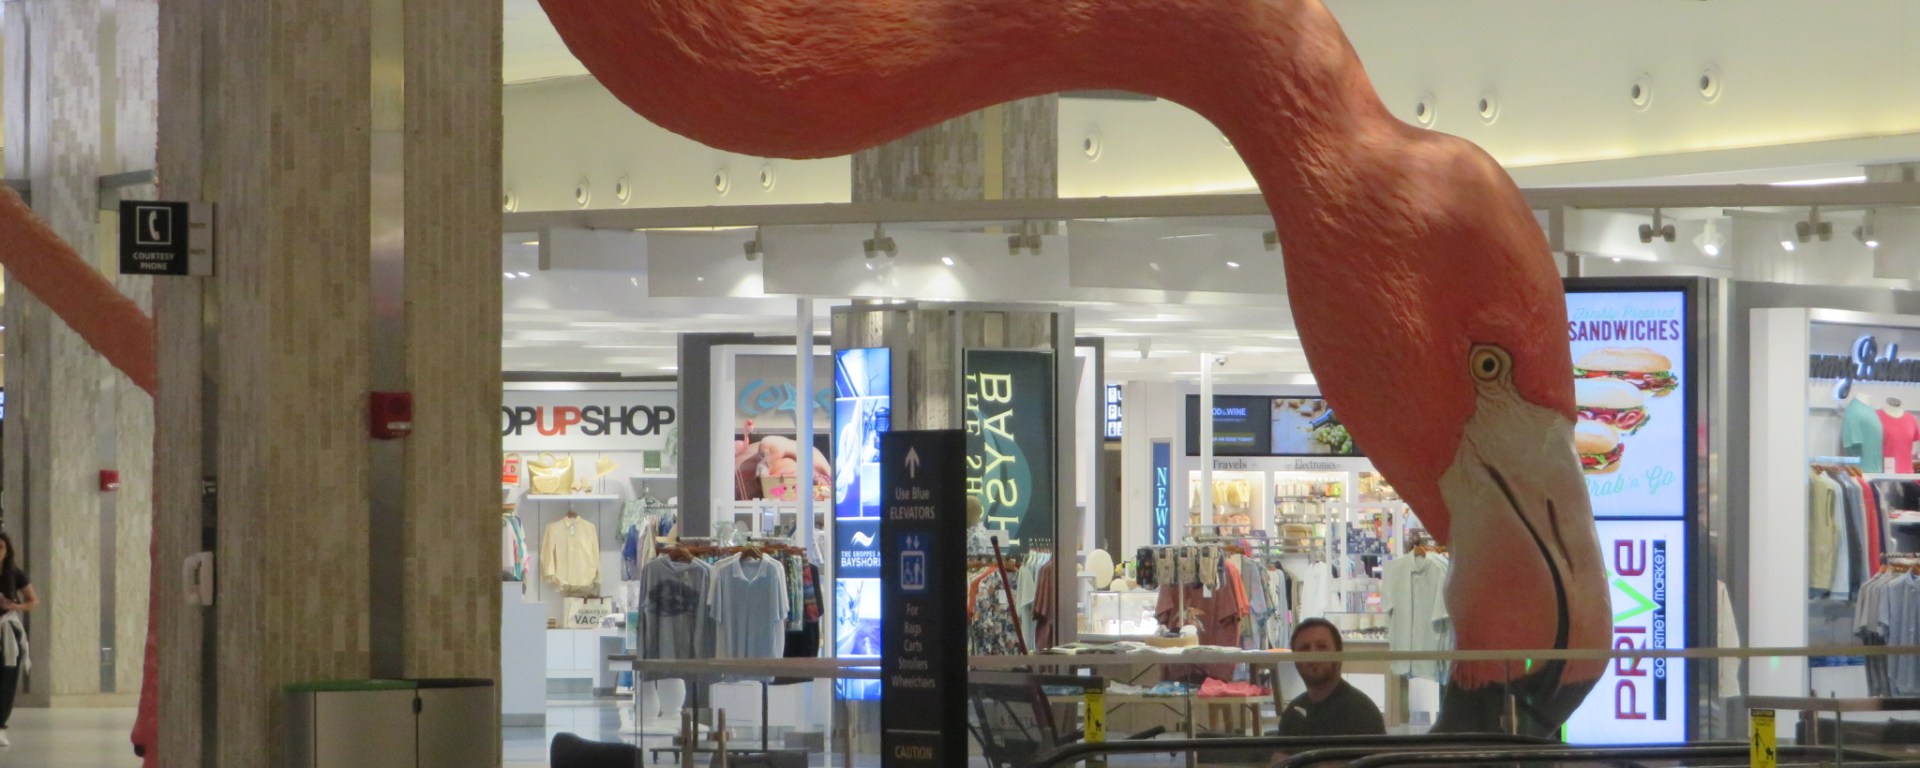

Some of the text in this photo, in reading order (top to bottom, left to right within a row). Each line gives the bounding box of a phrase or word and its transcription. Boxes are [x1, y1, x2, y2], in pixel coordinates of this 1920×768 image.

[132, 252, 175, 260] COURTESY
[140, 262, 167, 270] PHONE
[1568, 319, 1680, 341] SANDWICHES
[896, 487, 929, 499] Use Blue
[1155, 467, 1169, 545] NEWS
[890, 506, 935, 519] ELEVATORS
[906, 604, 918, 615] For
[904, 622, 921, 636] Bags
[904, 640, 922, 652] Carts
[898, 658, 928, 670] Strollers
[892, 676, 935, 688] Wheelchairs
[895, 746, 932, 759] CAUTION
